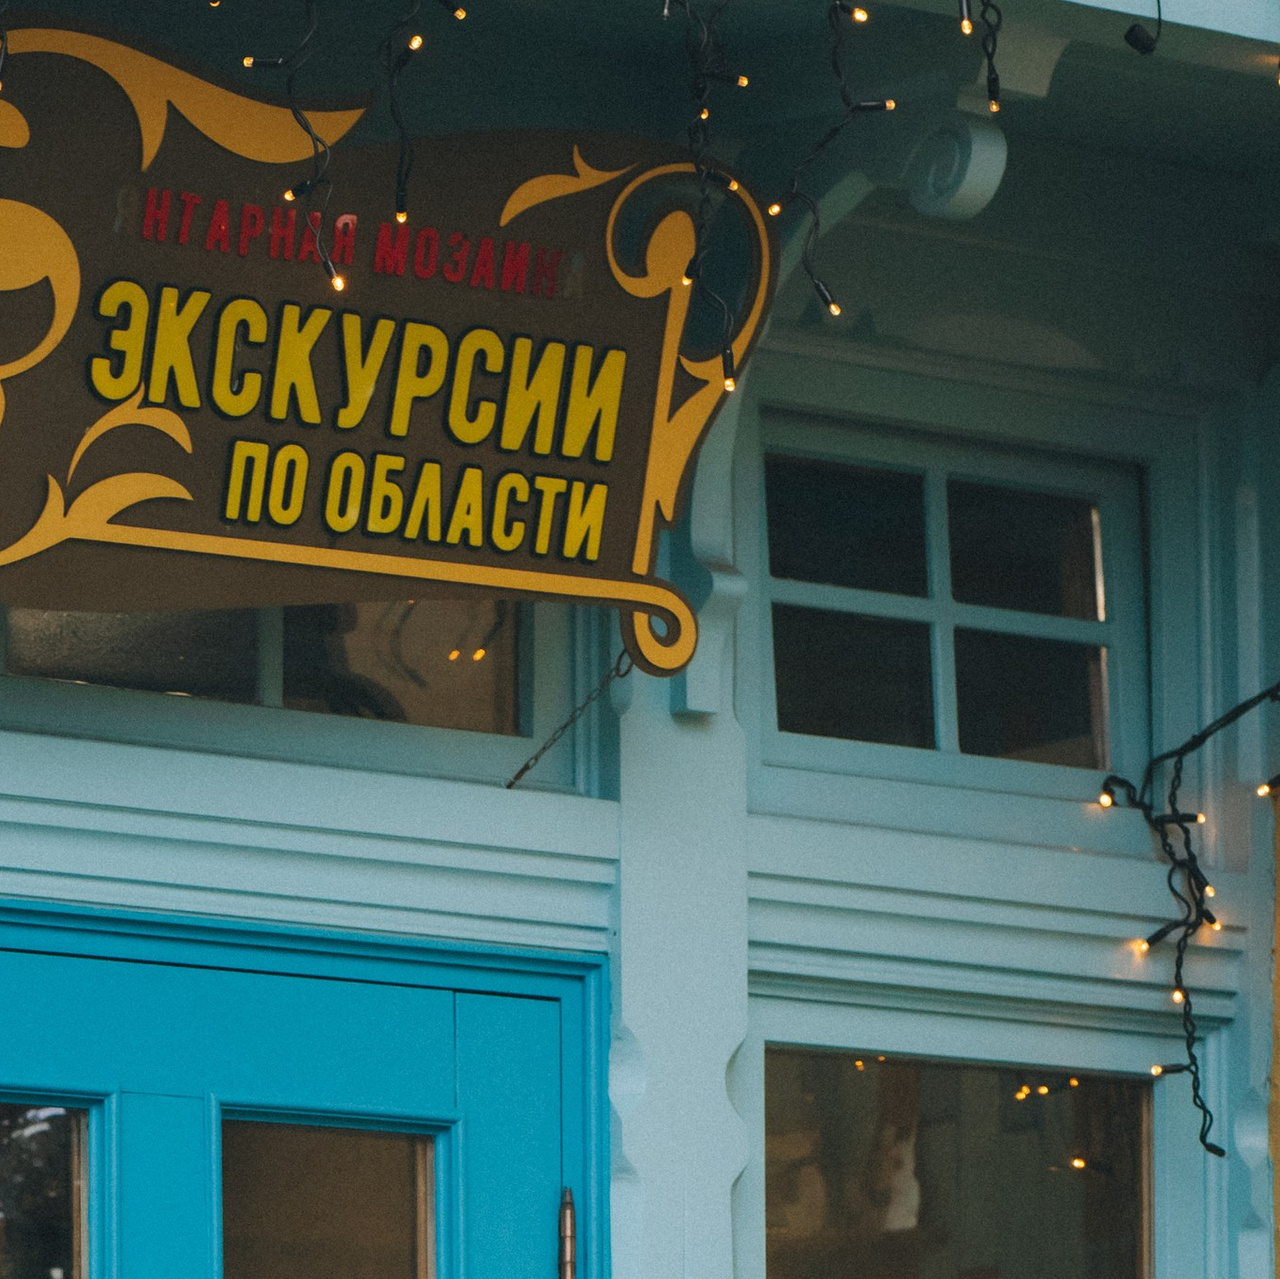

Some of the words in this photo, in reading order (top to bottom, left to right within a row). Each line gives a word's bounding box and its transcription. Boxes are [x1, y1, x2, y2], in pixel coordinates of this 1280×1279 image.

[114, 184, 358, 265] НТАРНАЯ
[90, 280, 627, 464] ЭКСКУРСИИ
[224, 440, 309, 527] ПО
[326, 452, 609, 564] ОБЛАСТИ
